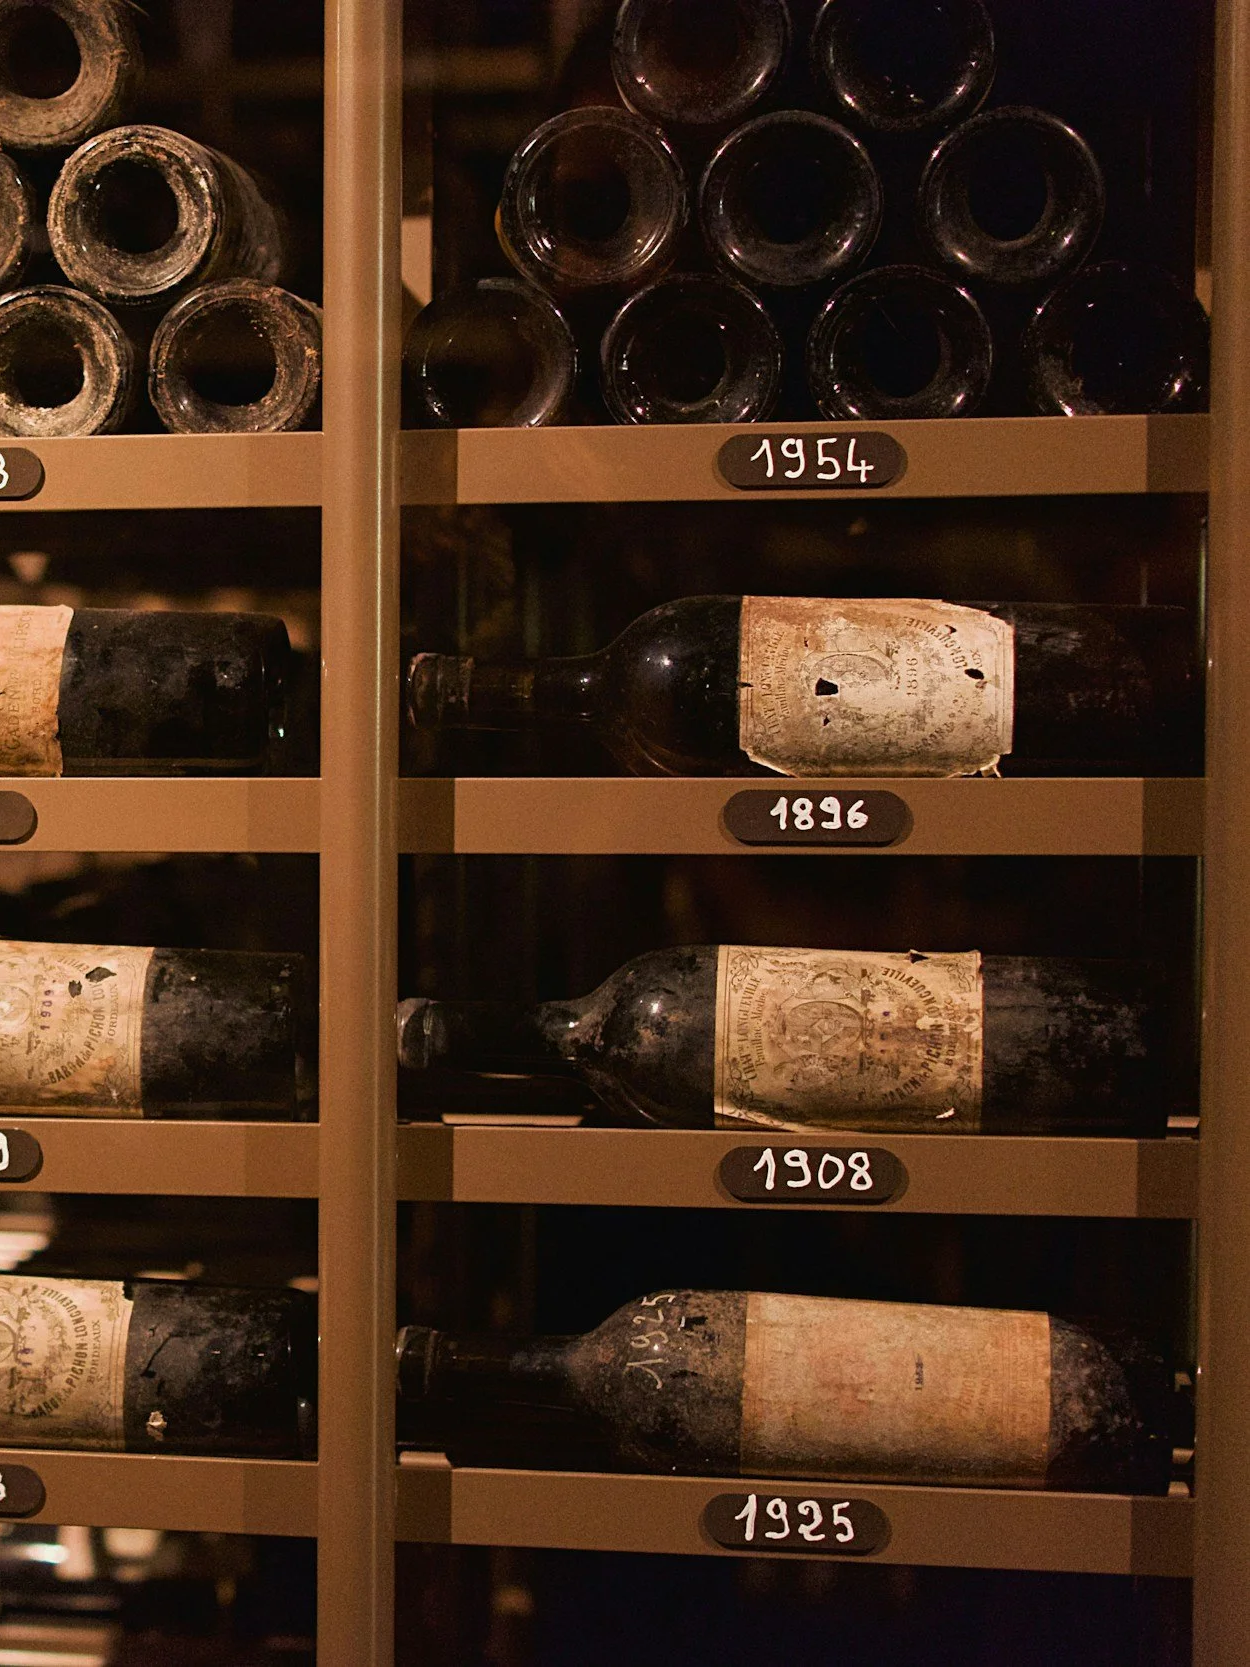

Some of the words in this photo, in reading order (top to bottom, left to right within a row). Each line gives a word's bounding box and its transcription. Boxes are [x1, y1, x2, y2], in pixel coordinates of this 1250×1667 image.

[750, 437, 875, 483] 1954
[906, 657, 918, 697] 1896
[4, 691, 21, 750] GADEN
[769, 796, 869, 831] 1896
[105, 983, 120, 1044] BORDEAUX
[48, 1054, 86, 1084] BARON
[83, 1007, 106, 1052] PICHON
[920, 1024, 944, 1073] PICHON
[753, 1147, 873, 1191] 1908
[65, 1342, 89, 1389] PICHON
[85, 1319, 102, 1385] BORDEAUX
[623, 1294, 676, 1390] 1925
[734, 1493, 855, 1543] 1925
